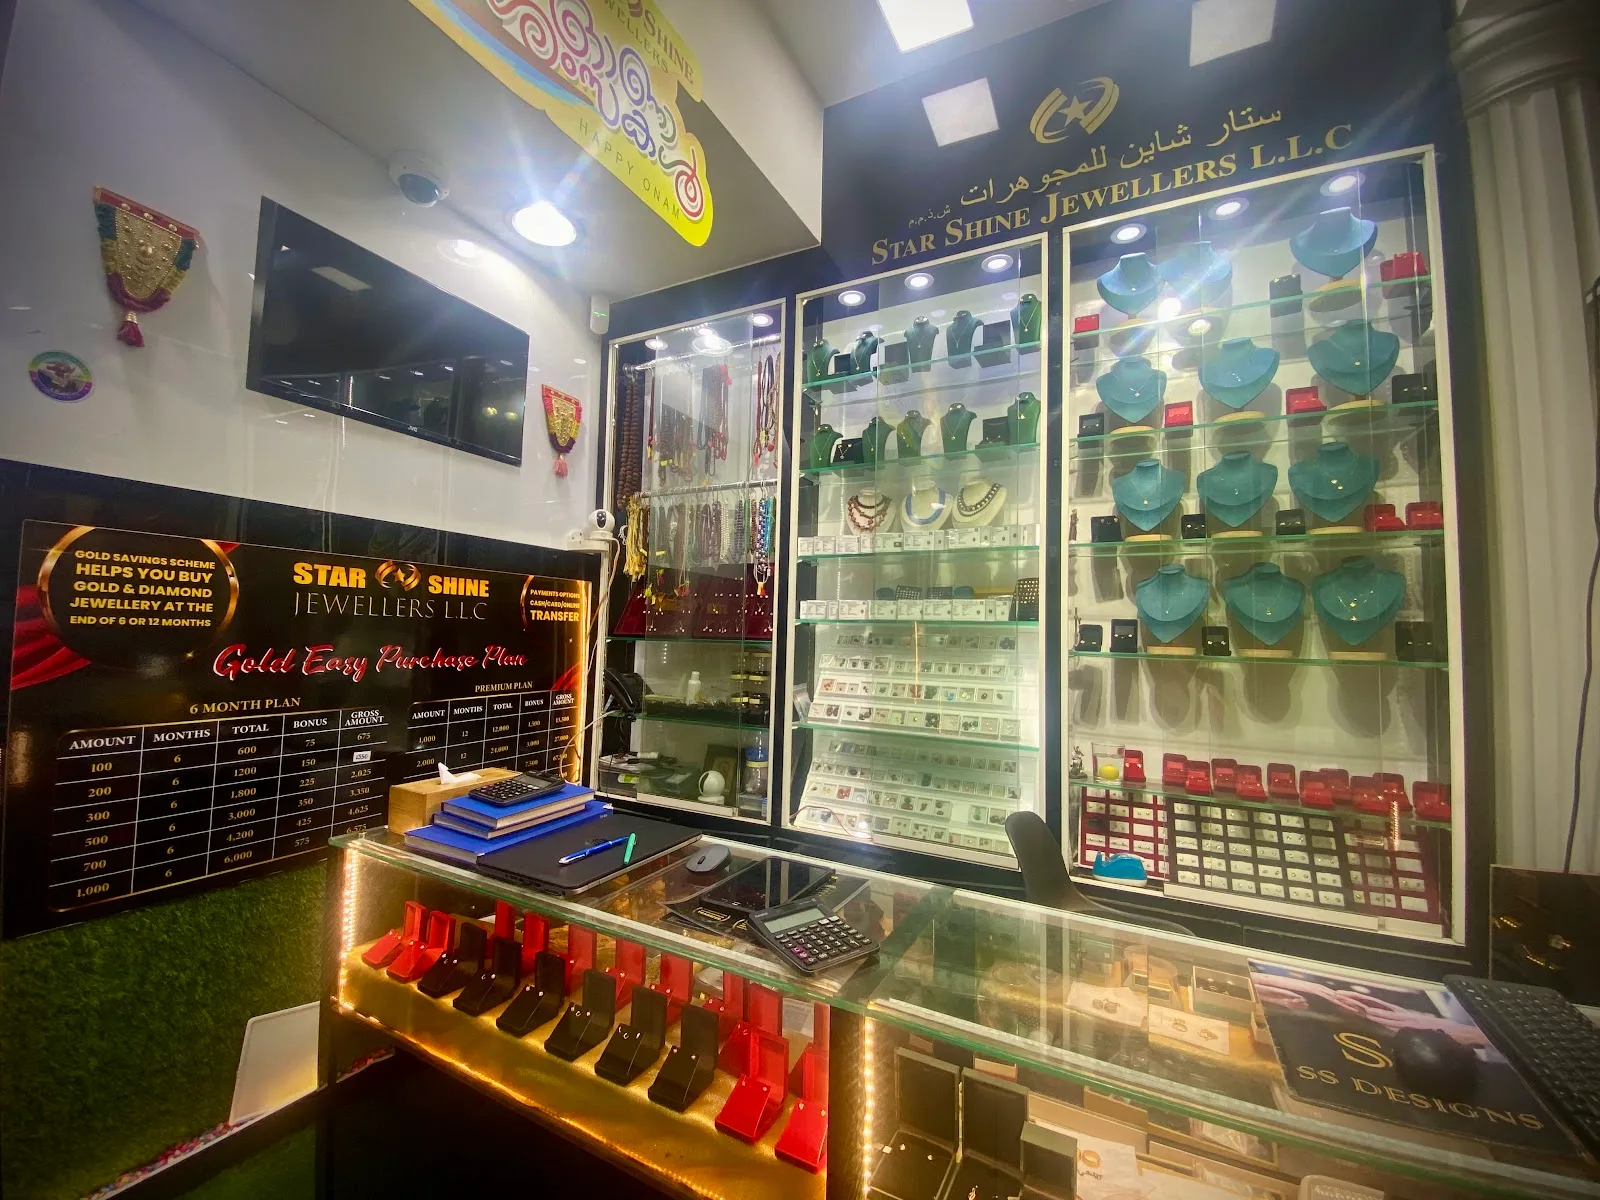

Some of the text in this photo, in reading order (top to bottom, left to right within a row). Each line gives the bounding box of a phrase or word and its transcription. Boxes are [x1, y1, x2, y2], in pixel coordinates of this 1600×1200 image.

[643, 9, 694, 84] SHINE
[1207, 106, 1282, 147] ستار
[1119, 122, 1192, 168] شاين
[579, 118, 681, 220] HAPPY ONAM
[871, 123, 1354, 266] STAR SHINE JEWELLERS L.L.C
[75, 550, 215, 570] GOLD SAVINGS SCHEME
[76, 563, 213, 584] HELPS YOU BUY
[74, 581, 213, 598] GOLD & DIAMOND
[293, 562, 489, 598] STAR SHINE
[530, 589, 558, 598] PAYMENTS
[69, 597, 214, 613] JEWELLERY AT THE
[294, 591, 488, 620] JEWELLERS L.L.C
[530, 610, 580, 622] TRANSFER
[70, 616, 211, 627] END OF 6 OR 12 MONTHS
[213, 643, 297, 681] Gold
[376, 645, 478, 673] Purchase
[481, 645, 528, 668] Plan
[475, 681, 533, 692] PREMIUM PLAN
[552, 698, 574, 706] AMOUNT
[190, 698, 301, 714] 6 MONTH PLAN
[345, 716, 384, 726] AMOUNT
[351, 710, 379, 718] GROSS
[412, 698, 543, 719] AMOUNT MONTHS TOTAL BONUS
[69, 718, 328, 750] AMOUNT MONTHS TOTAL BONUS
[91, 762, 113, 773] 100
[174, 755, 181, 763] 6
[237, 746, 257, 755] 600
[305, 739, 316, 747] 75
[88, 787, 112, 798] 200
[172, 778, 180, 786] 6
[234, 767, 257, 777] 1200
[301, 759, 316, 767] 150
[86, 811, 110, 823] 300
[170, 801, 178, 809] 6
[230, 788, 257, 799] 1,800
[299, 778, 315, 787] 225
[84, 835, 108, 847] 500
[168, 823, 176, 832] 6
[228, 809, 256, 821] 3,000
[298, 798, 313, 807] 350
[83, 860, 107, 872] 700
[166, 846, 174, 855] 6
[226, 830, 254, 842] 4,200
[296, 817, 312, 827] 425
[165, 869, 173, 877] 6
[224, 851, 252, 863] 6,000
[294, 837, 310, 847] 575
[1297, 1066, 1545, 1130] SS DESIGNS
